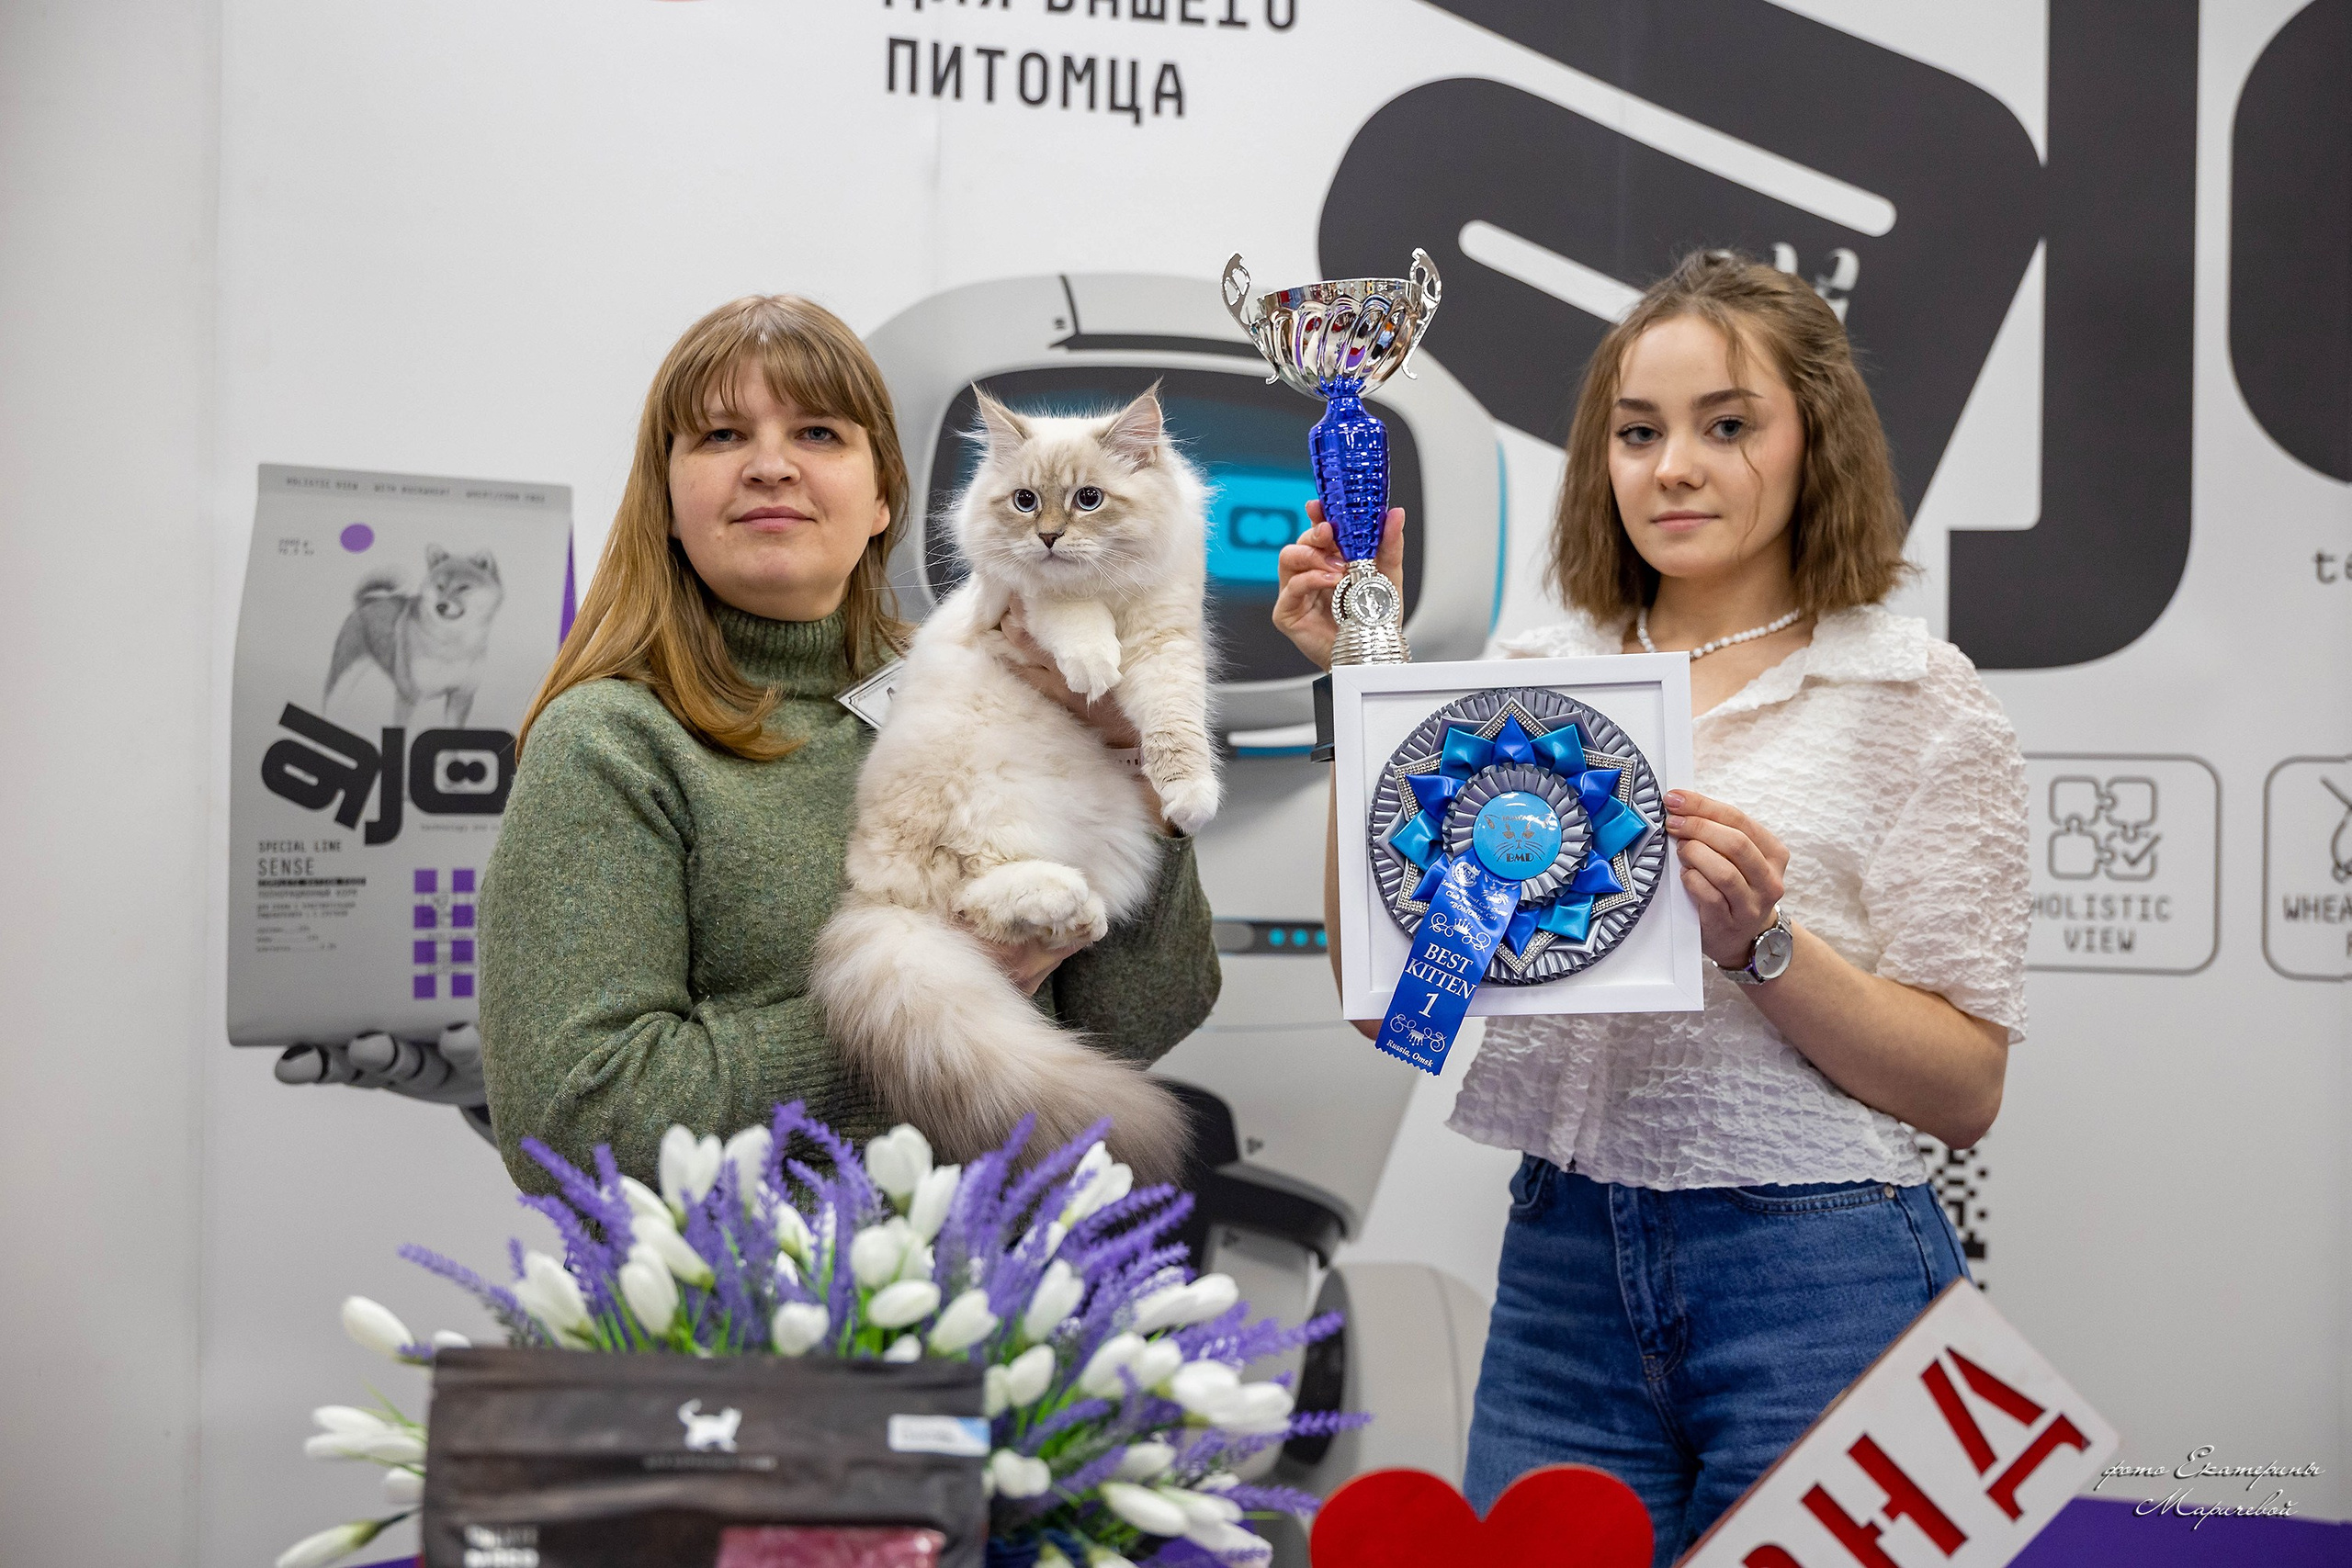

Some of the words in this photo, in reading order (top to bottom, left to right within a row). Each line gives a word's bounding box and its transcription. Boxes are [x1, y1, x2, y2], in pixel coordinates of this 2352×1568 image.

[888, 37, 1185, 126] ПИТОМЦА
[259, 840, 305, 853] SPECIAL
[313, 839, 341, 852] LINE
[1507, 852, 1534, 863] BMD
[258, 857, 314, 876] SENSE
[2029, 892, 2173, 922] HOLISTIC
[2064, 926, 2137, 954] VIEW
[1423, 942, 1474, 975] BEST
[1405, 957, 1477, 999] KITTEN
[1419, 992, 1440, 1018] 1
[1386, 1039, 1411, 1058] Russia,
[1412, 1052, 1434, 1067] Omsk
[1739, 1345, 2092, 1568] НД
